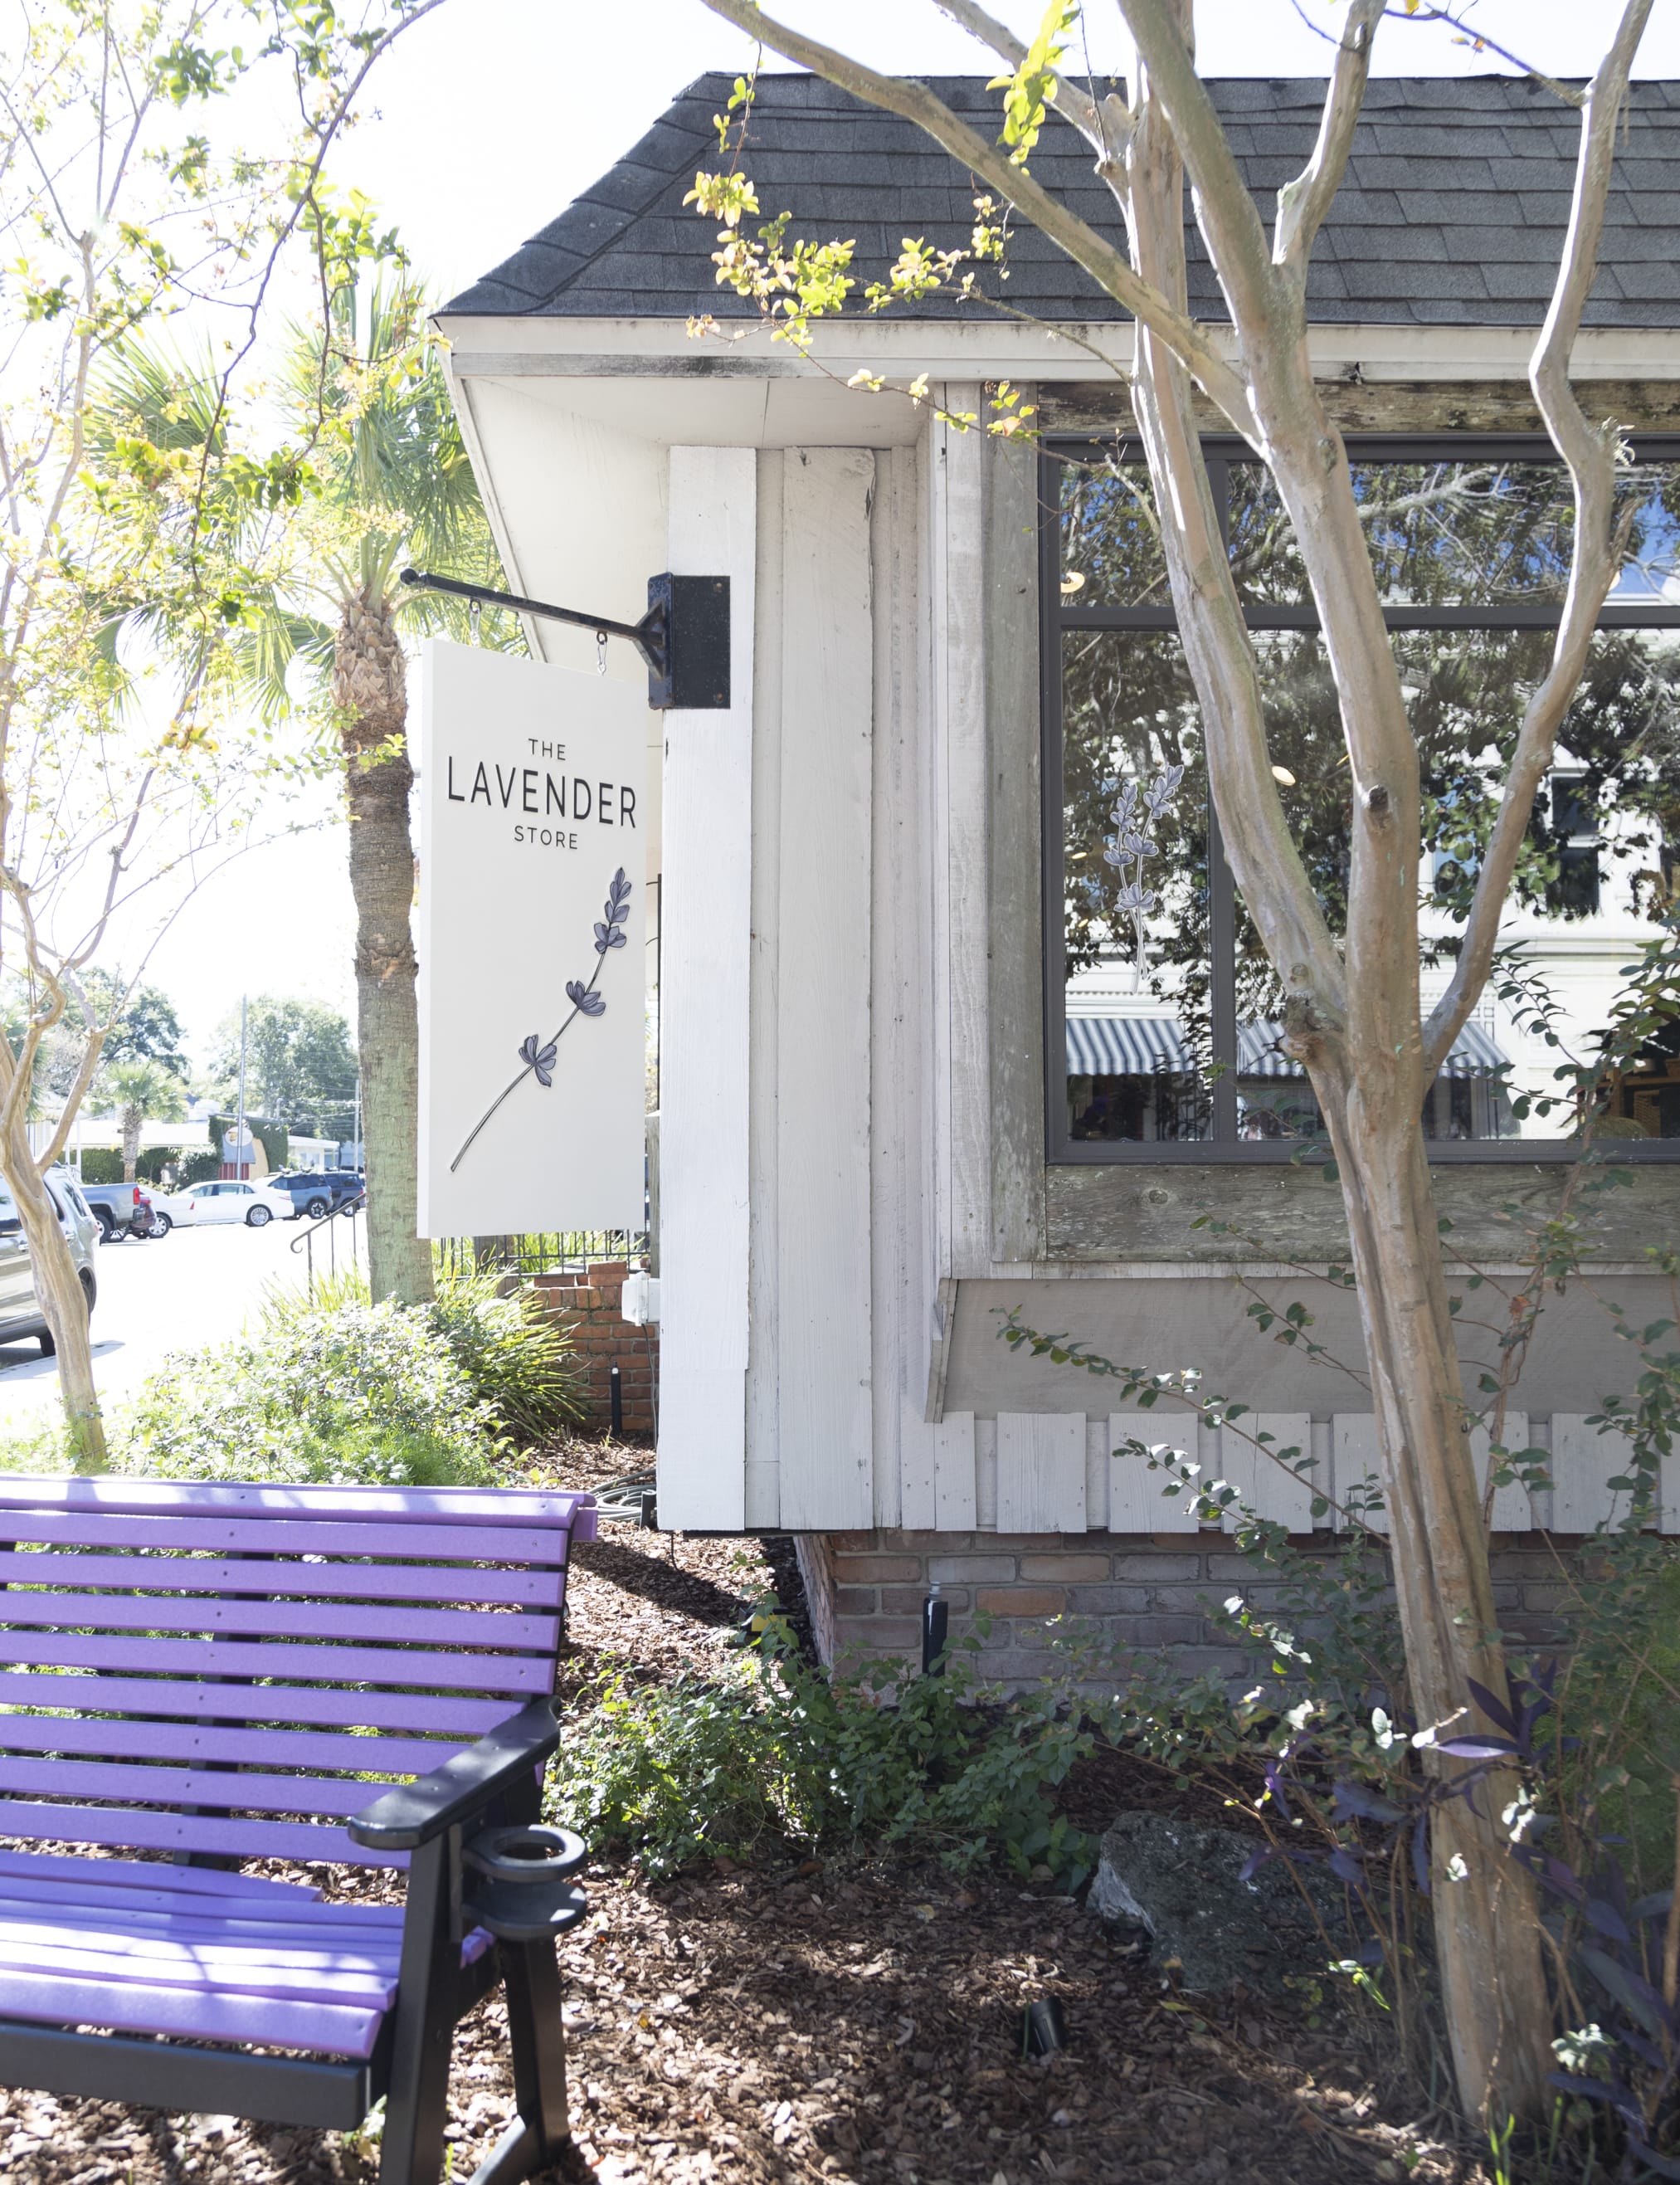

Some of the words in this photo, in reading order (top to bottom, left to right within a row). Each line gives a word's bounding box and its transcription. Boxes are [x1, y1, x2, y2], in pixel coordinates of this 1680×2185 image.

[528, 738, 567, 761] THE
[448, 755, 636, 829] LAVENDER
[514, 825, 578, 850] STORE
